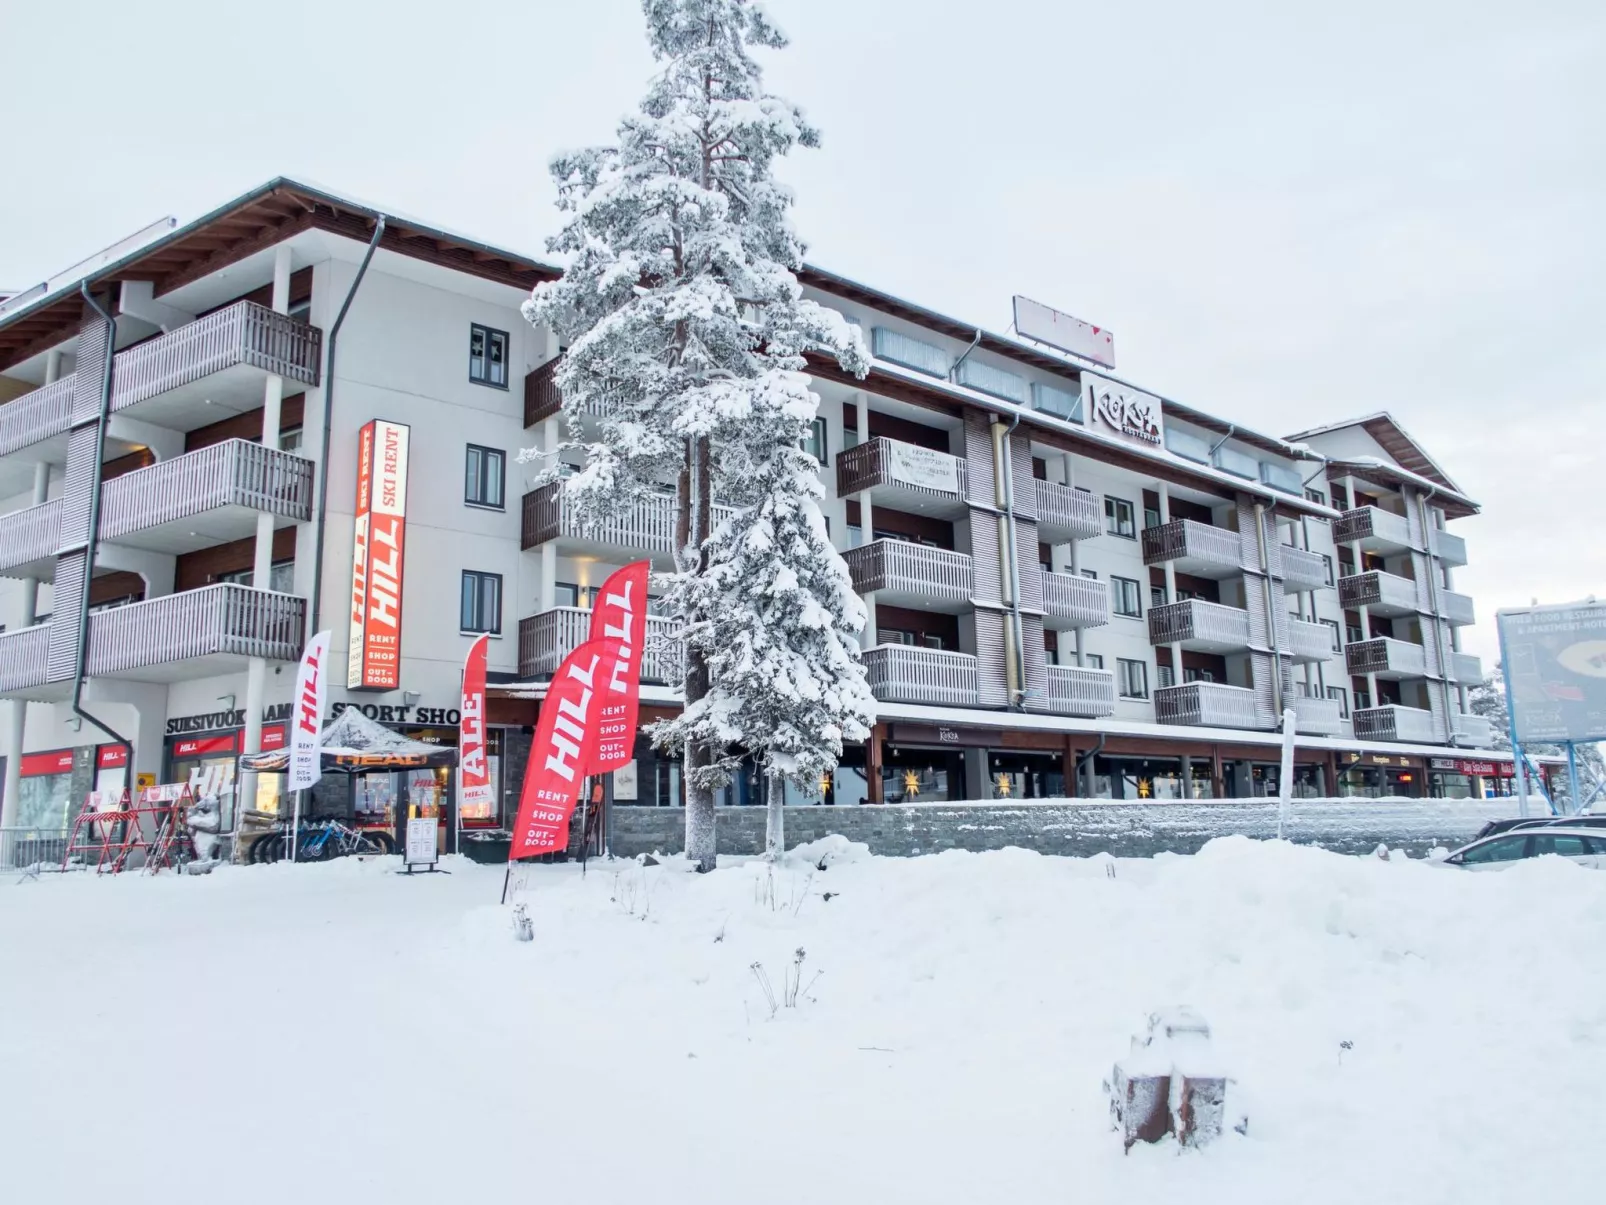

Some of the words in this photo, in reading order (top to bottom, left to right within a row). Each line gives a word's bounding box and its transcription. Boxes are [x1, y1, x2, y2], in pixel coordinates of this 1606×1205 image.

[361, 430, 371, 477] RENT
[384, 427, 399, 475] RENT
[360, 479, 368, 509] SKI
[382, 478, 397, 507] SKI
[353, 520, 367, 625] HILL
[371, 519, 399, 629] HILL
[369, 634, 396, 644] RENT
[368, 652, 395, 661] SHOP
[367, 668, 393, 676] OUT-
[367, 676, 394, 684] DOOR
[299, 646, 322, 735] HILL
[416, 708, 461, 724] SHO
[601, 705, 627, 716] RENT
[544, 653, 601, 784] HILL
[462, 693, 485, 778] ALE
[600, 724, 627, 734] SHOP
[179, 742, 197, 753] HILL
[600, 743, 624, 752] OUT-
[600, 751, 626, 761] DOOR
[537, 789, 570, 803] RENT
[532, 809, 564, 822] SHOP
[527, 829, 555, 839] OUT-
[525, 838, 554, 846] DOOR
